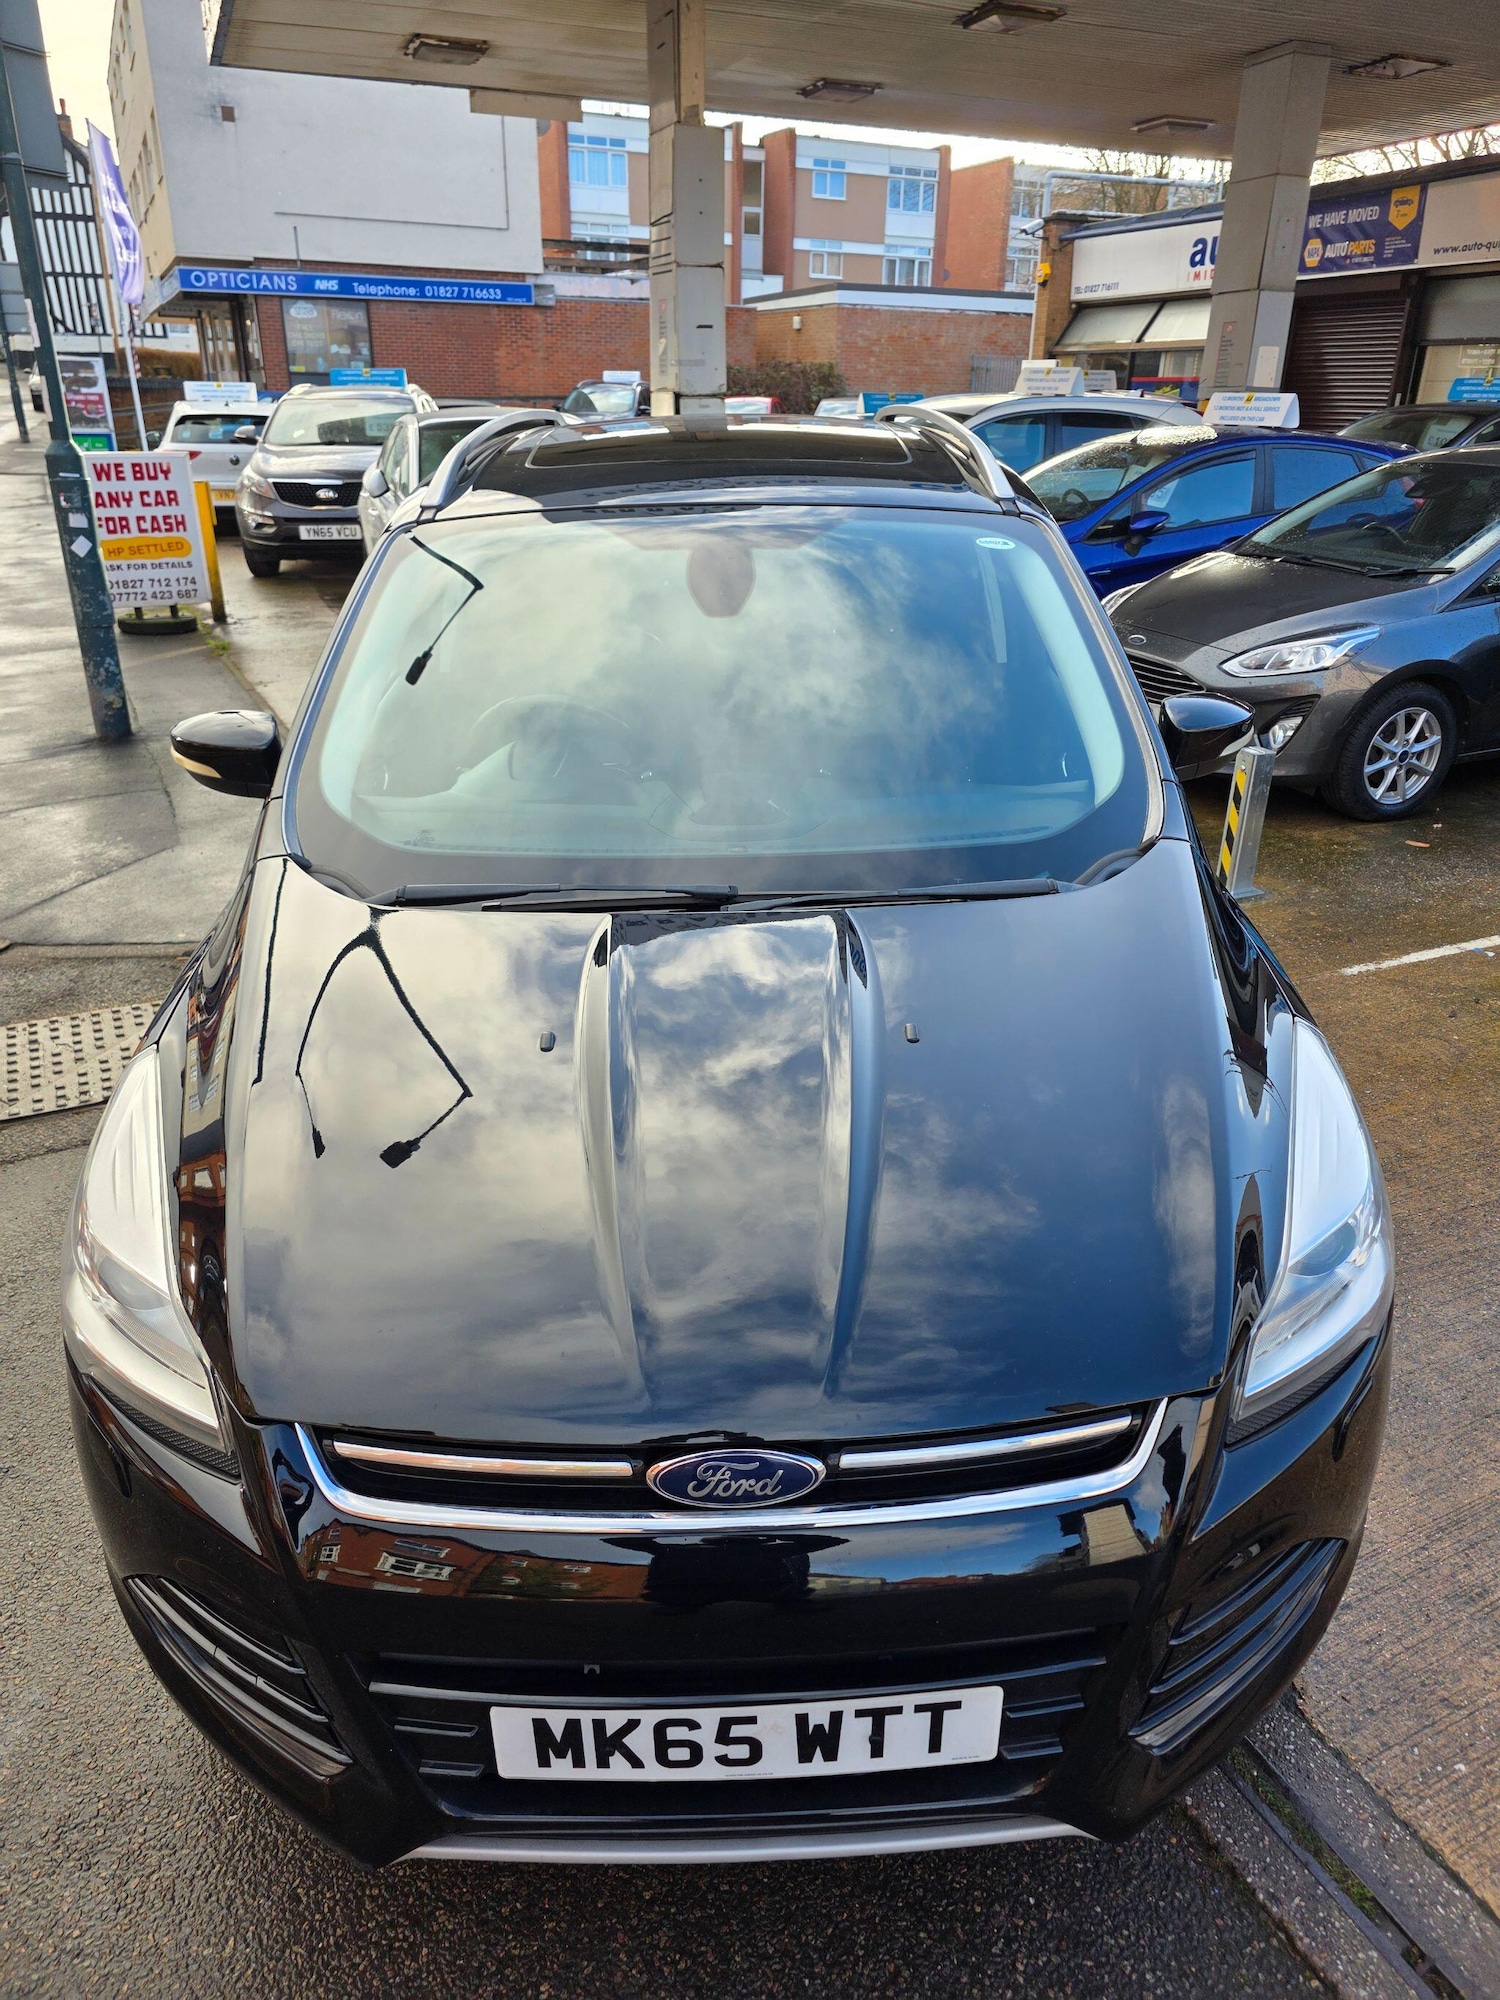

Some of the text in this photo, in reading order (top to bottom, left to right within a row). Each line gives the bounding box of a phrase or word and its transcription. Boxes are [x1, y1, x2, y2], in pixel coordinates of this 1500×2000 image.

[1308, 214, 1323, 229] WE
[1323, 210, 1347, 227] HAVE
[1347, 206, 1380, 224] MOVED
[190, 270, 298, 291] OPTICIANS
[314, 279, 339, 291] NHS
[352, 282, 420, 296] Telephone:
[424, 285, 458, 298] 01827
[462, 287, 502, 300] 716633
[92, 461, 172, 482] WE BUY
[95, 489, 180, 509] ANY CAR
[136, 514, 188, 534] CASH
[305, 526, 357, 538] YN65 VCU
[107, 541, 184, 558] HP SETTLED
[127, 562, 148, 571] FOR
[151, 560, 193, 571] DETAILS
[149, 578, 172, 588] 712
[175, 576, 197, 587] 174
[151, 590, 173, 600] 423
[177, 588, 198, 598] 687
[687, 1461, 784, 1498] Ford
[531, 1700, 962, 1770] MK65 WTT
